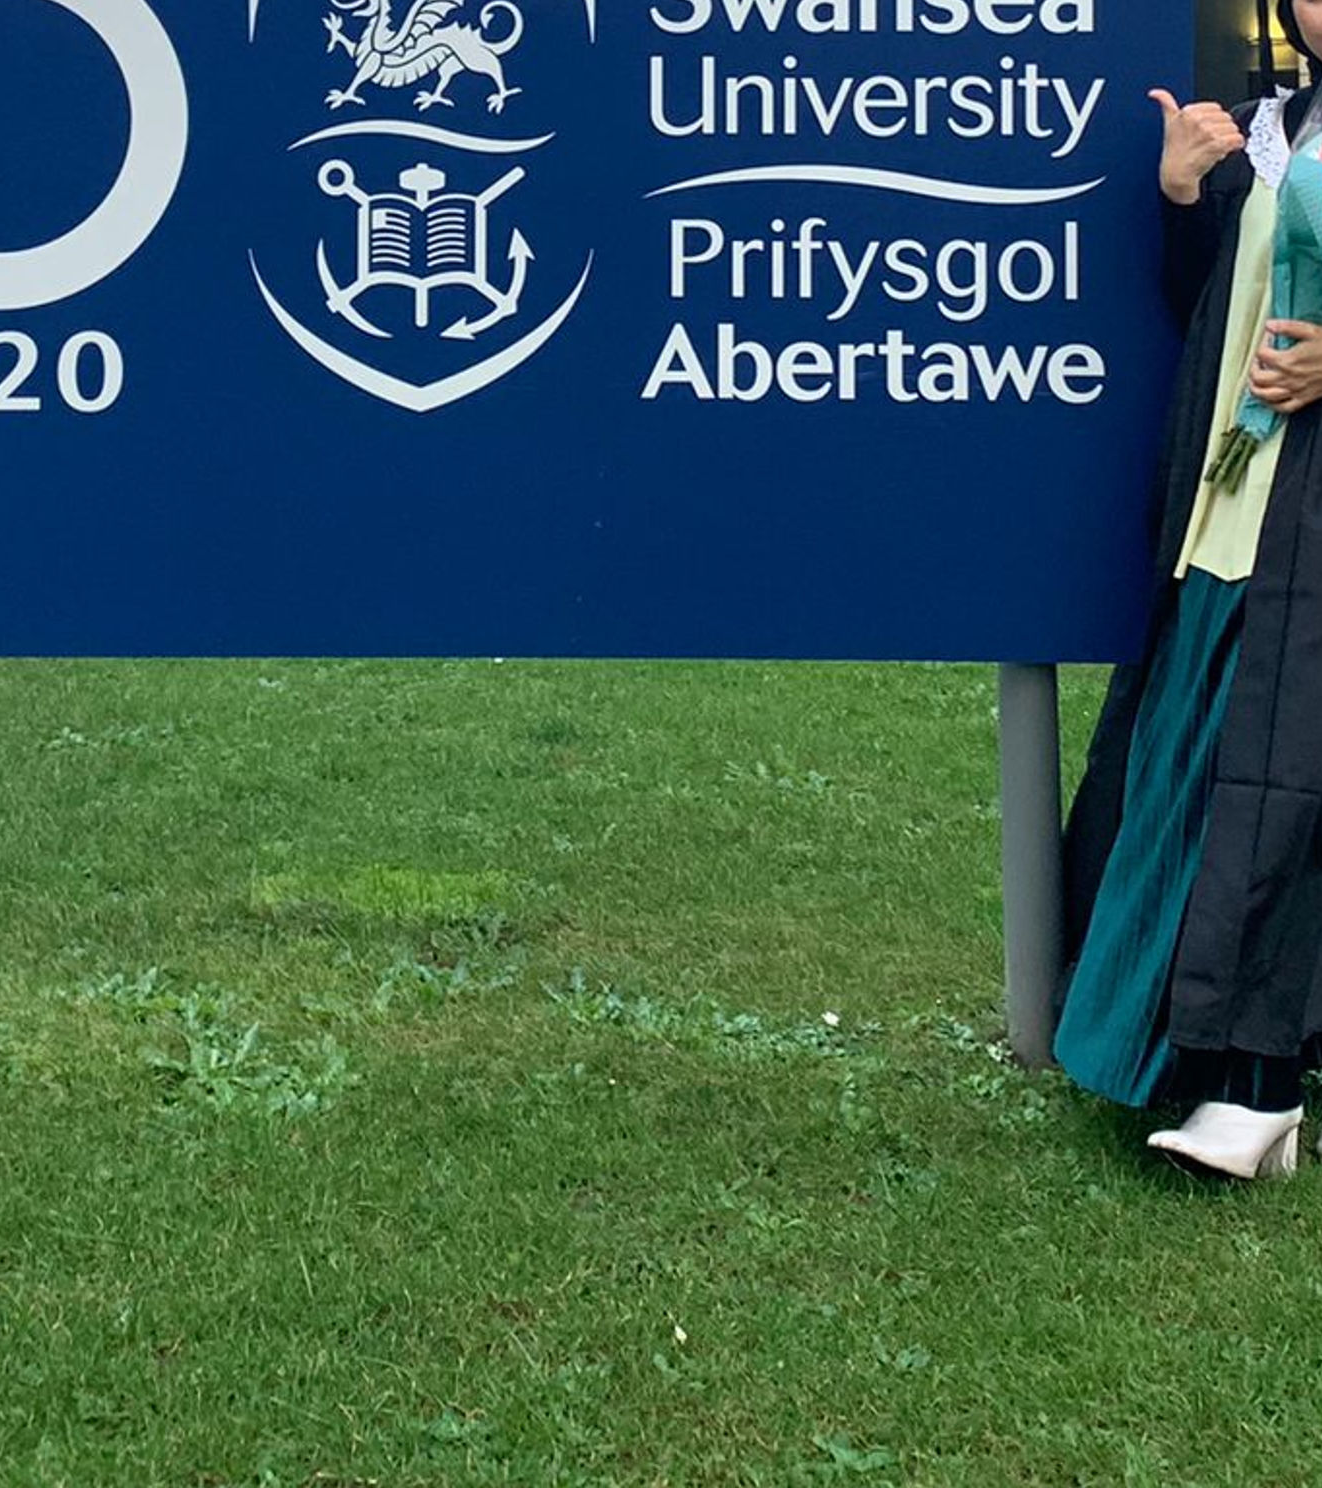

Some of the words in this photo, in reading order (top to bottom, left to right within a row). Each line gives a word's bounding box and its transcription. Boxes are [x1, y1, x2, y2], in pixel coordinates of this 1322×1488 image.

[650, 55, 1105, 159] University
[671, 217, 1079, 322] Prifysgol
[641, 323, 1105, 404] Abertawe
